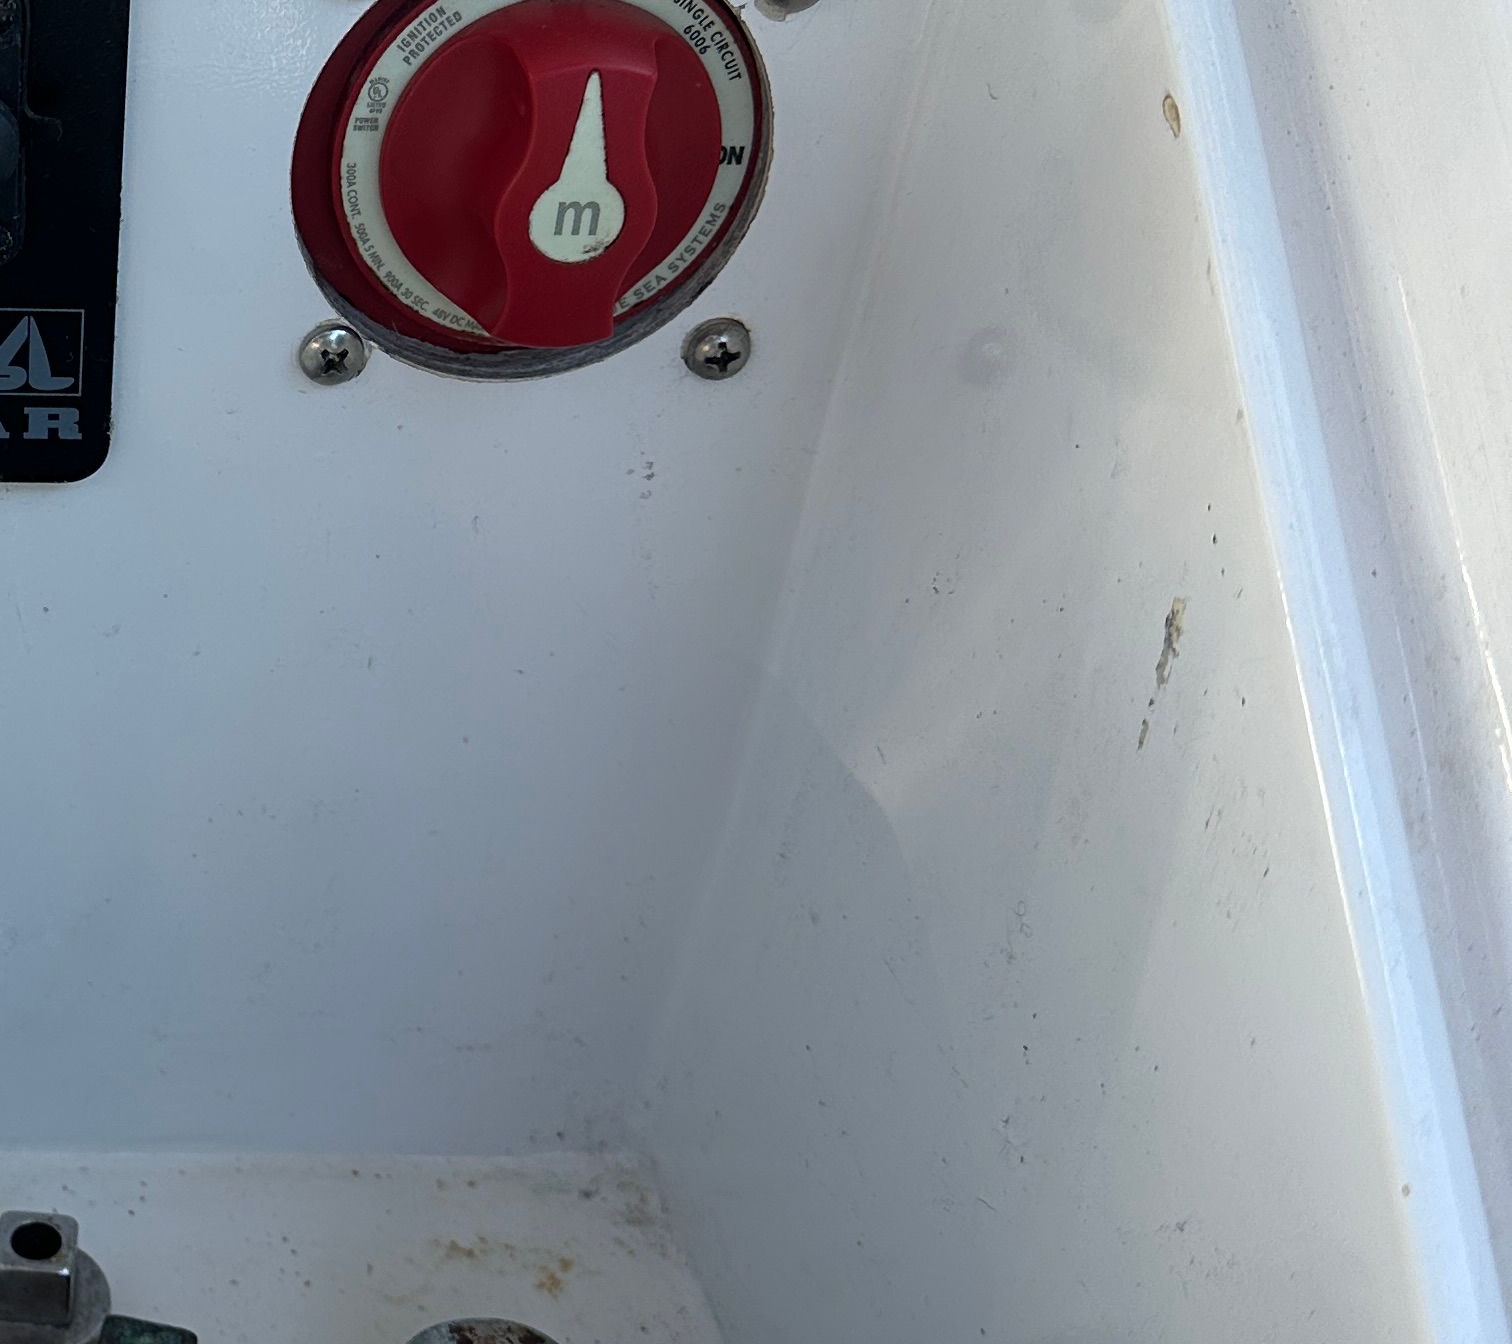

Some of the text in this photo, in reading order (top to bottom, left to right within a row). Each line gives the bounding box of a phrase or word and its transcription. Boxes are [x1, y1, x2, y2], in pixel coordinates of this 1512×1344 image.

[396, 5, 447, 53] IGNITION
[402, 10, 463, 66] PROTECTED
[683, 23, 708, 56] 6006
[710, 30, 744, 82] CIRCUIT
[346, 162, 357, 188] 300A
[347, 189, 362, 220] CONT.
[354, 222, 370, 247] 500A
[633, 201, 727, 300] SEA SYSTEMS
